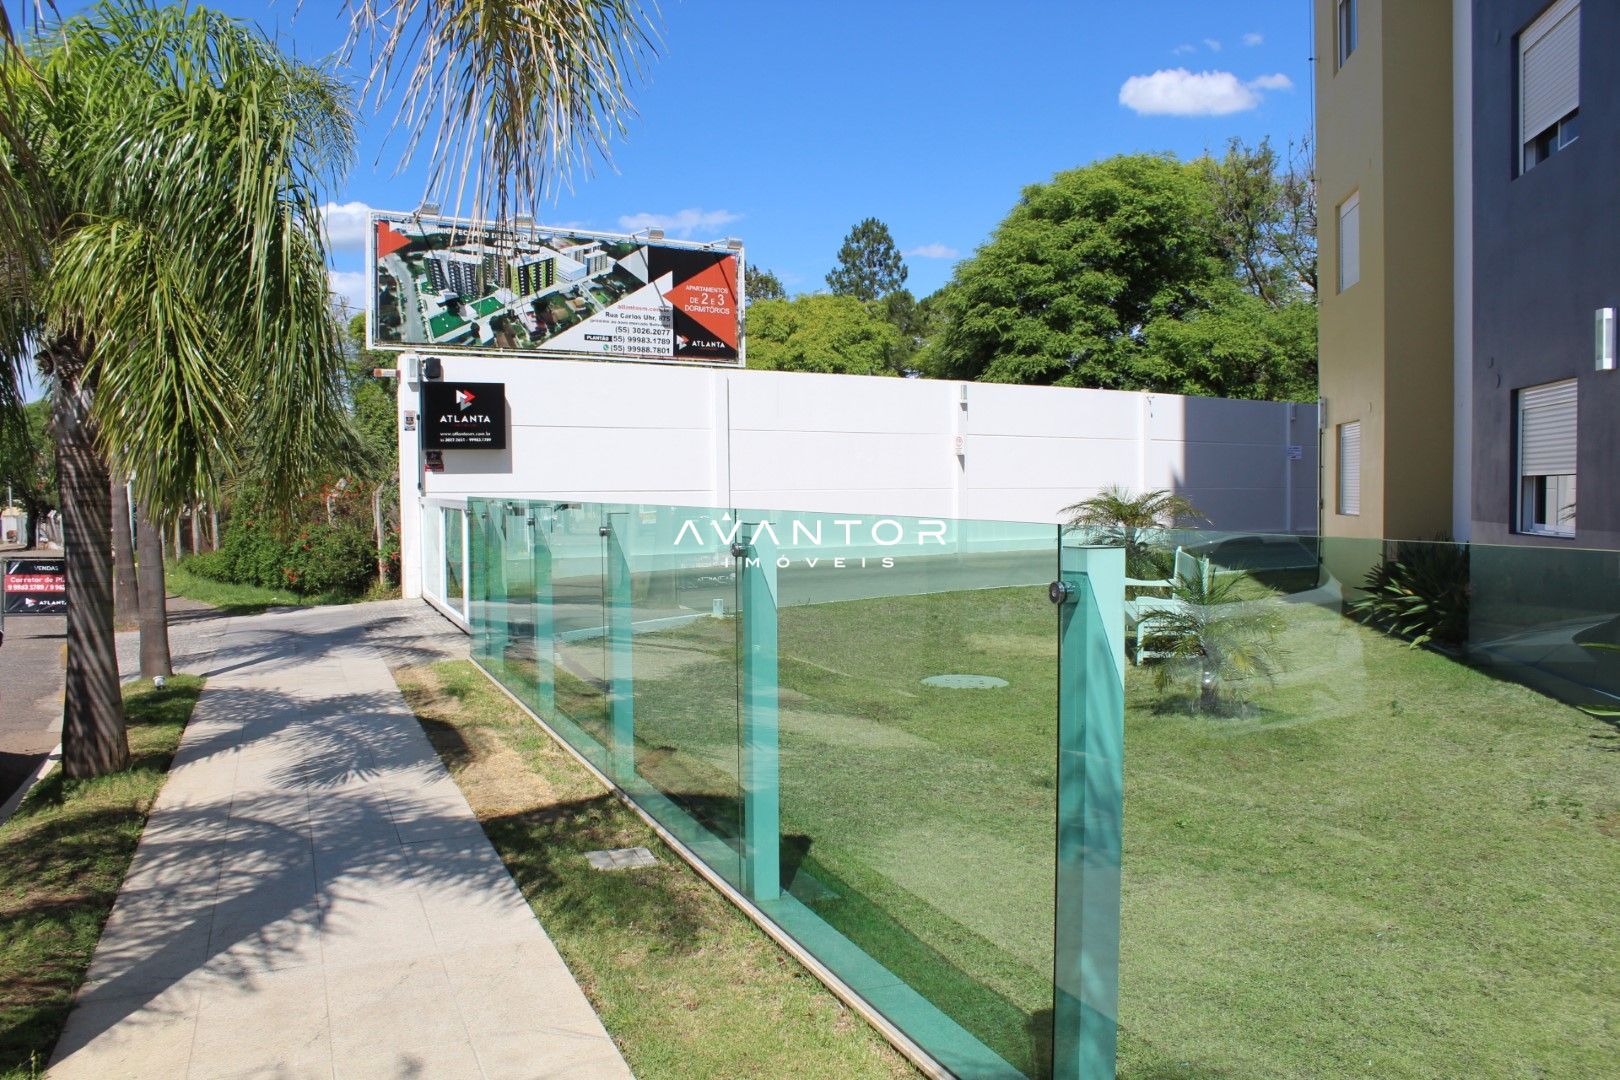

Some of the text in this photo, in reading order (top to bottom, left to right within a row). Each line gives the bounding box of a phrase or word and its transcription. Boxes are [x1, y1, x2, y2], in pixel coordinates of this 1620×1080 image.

[686, 285, 728, 294] APARTAMENTOS
[701, 293, 709, 305] 2
[717, 294, 725, 306] 3
[684, 304, 730, 315] DORMITÓRIOS
[615, 326, 671, 336] (55) 3026.2077
[627, 336, 671, 345] 99983.1789
[691, 340, 726, 348] ATLANTA
[610, 344, 671, 354] (55) 99988.7801
[439, 415, 491, 423] ATLANTA
